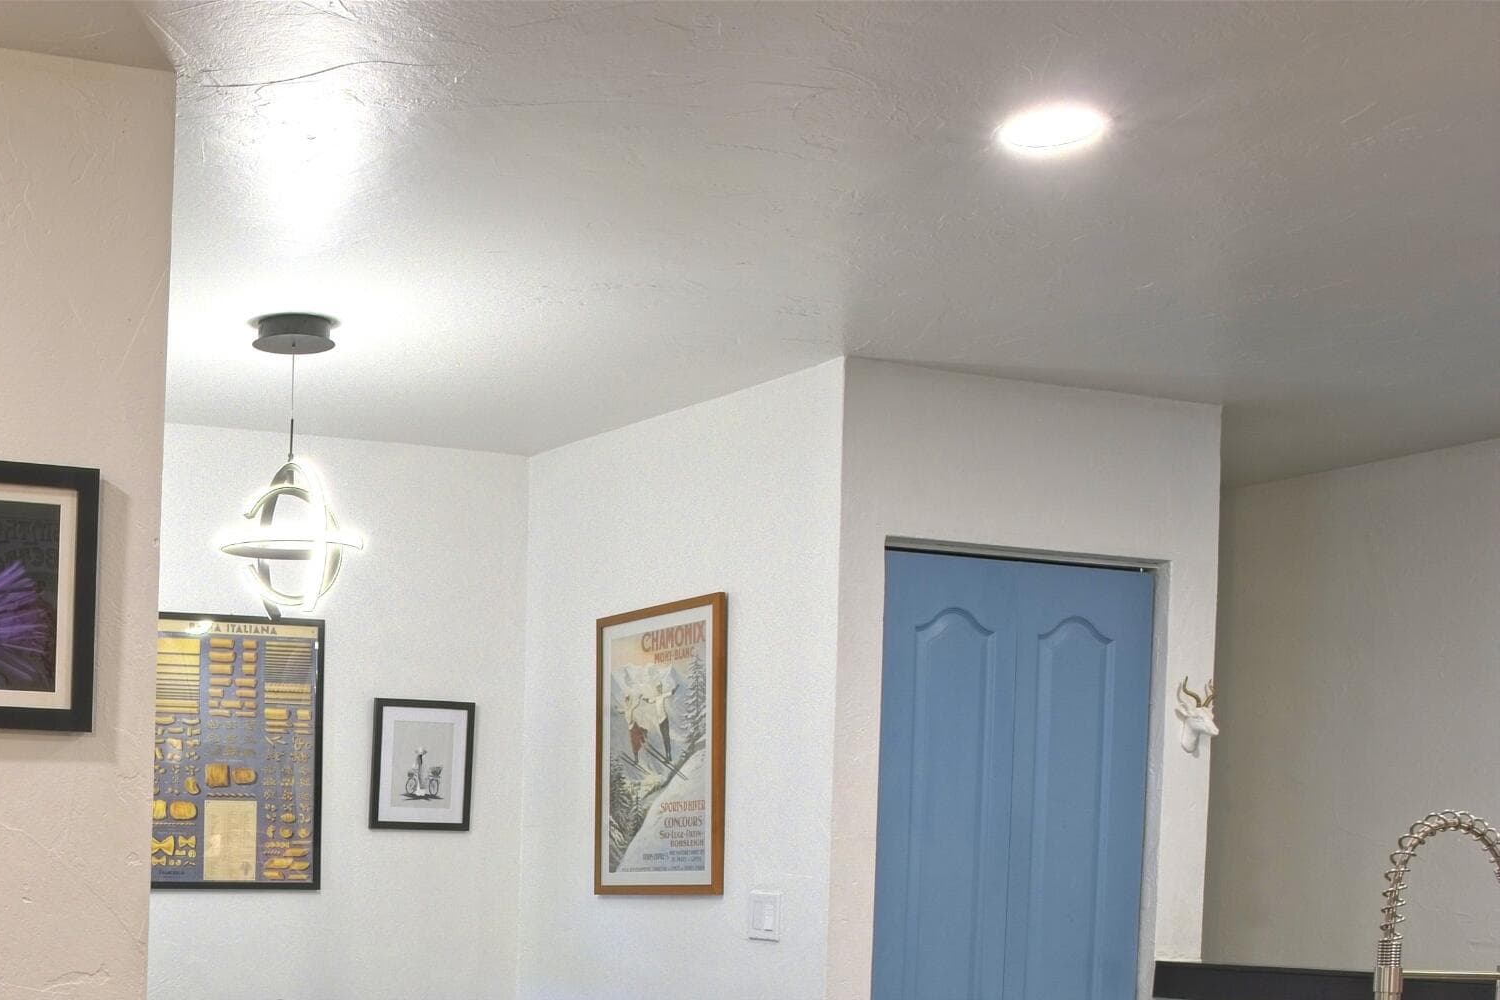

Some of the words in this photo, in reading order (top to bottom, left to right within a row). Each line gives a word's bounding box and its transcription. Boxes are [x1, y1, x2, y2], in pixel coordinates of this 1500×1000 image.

[227, 623, 277, 634] ITALIANA
[641, 620, 707, 652] CHAMONIX
[664, 816, 703, 828] CONCOURS
